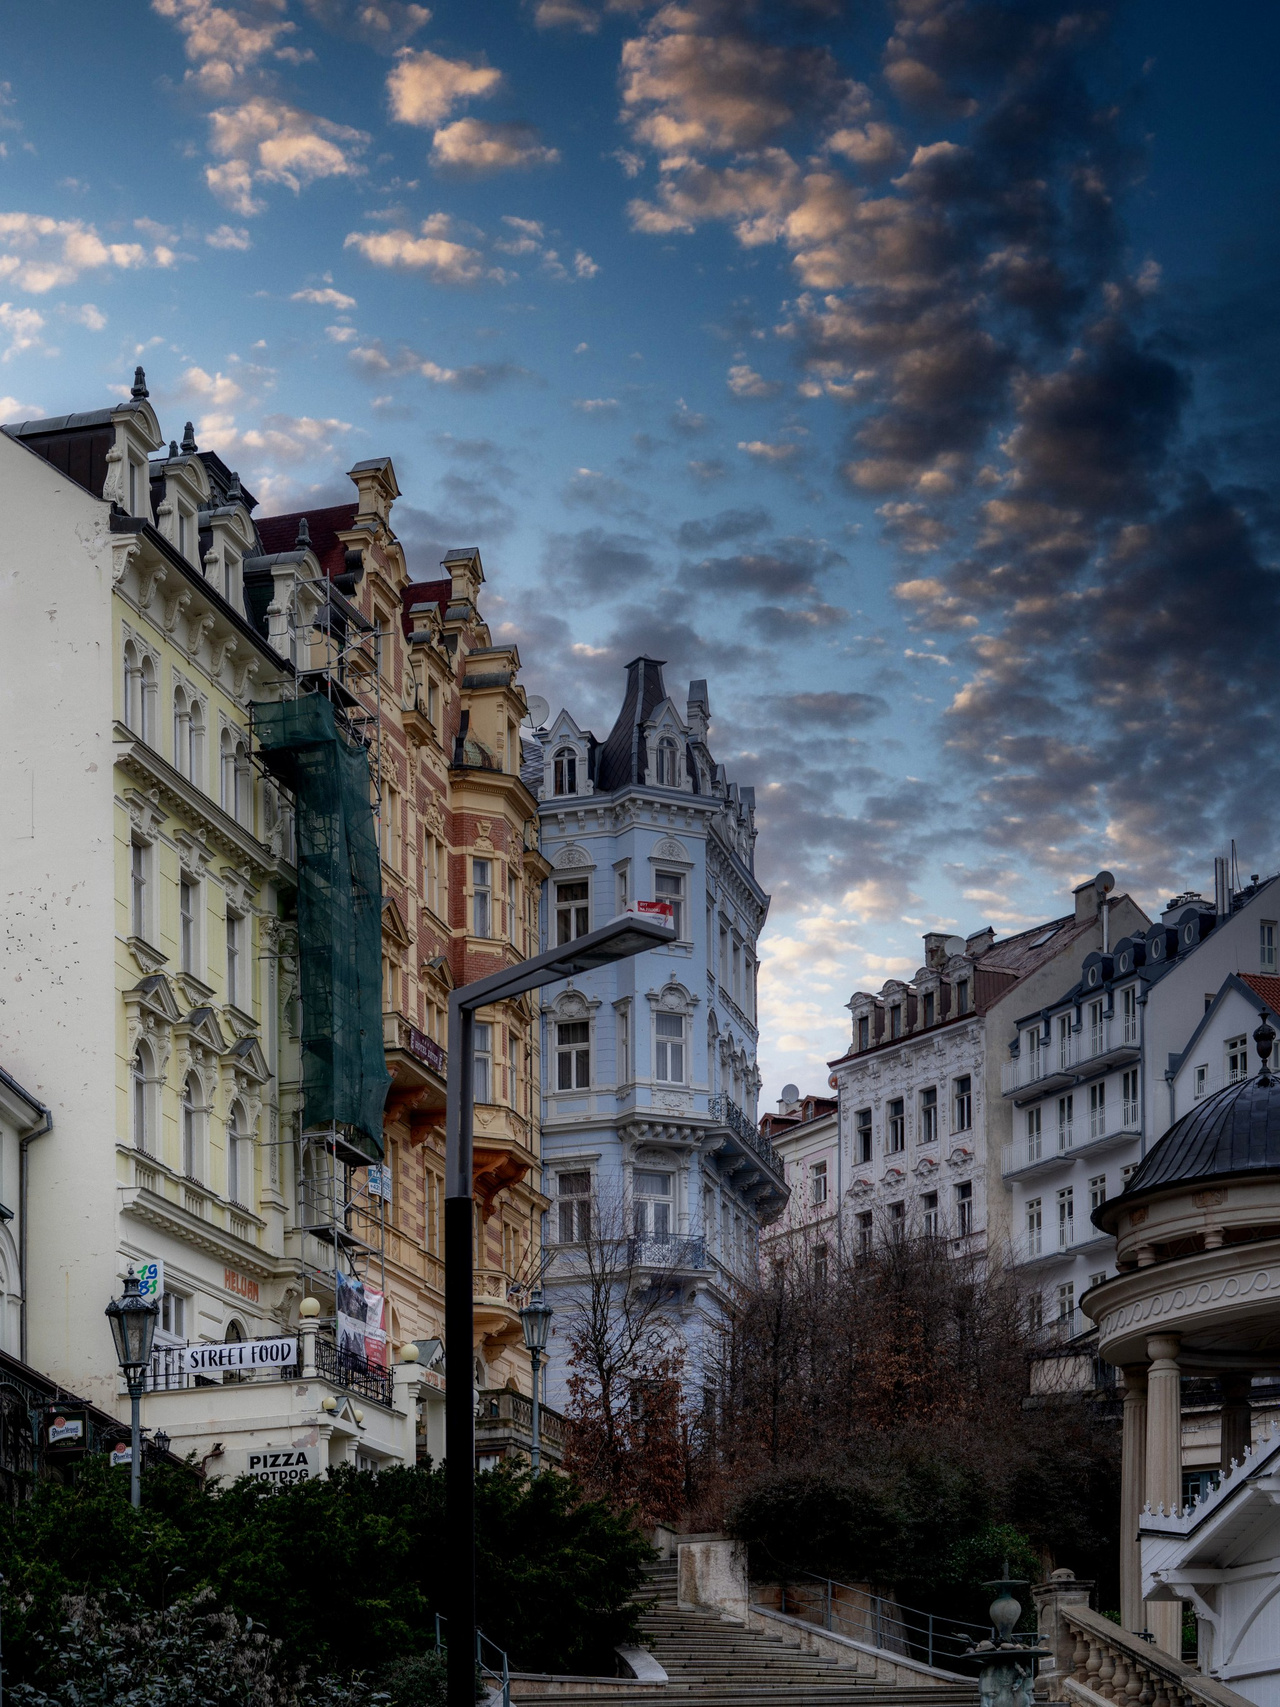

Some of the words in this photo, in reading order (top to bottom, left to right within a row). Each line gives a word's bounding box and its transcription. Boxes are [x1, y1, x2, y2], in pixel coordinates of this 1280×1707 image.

[190, 1346, 247, 1369] STREET
[251, 1343, 291, 1364] FOOD
[250, 1452, 308, 1469] PIZZA
